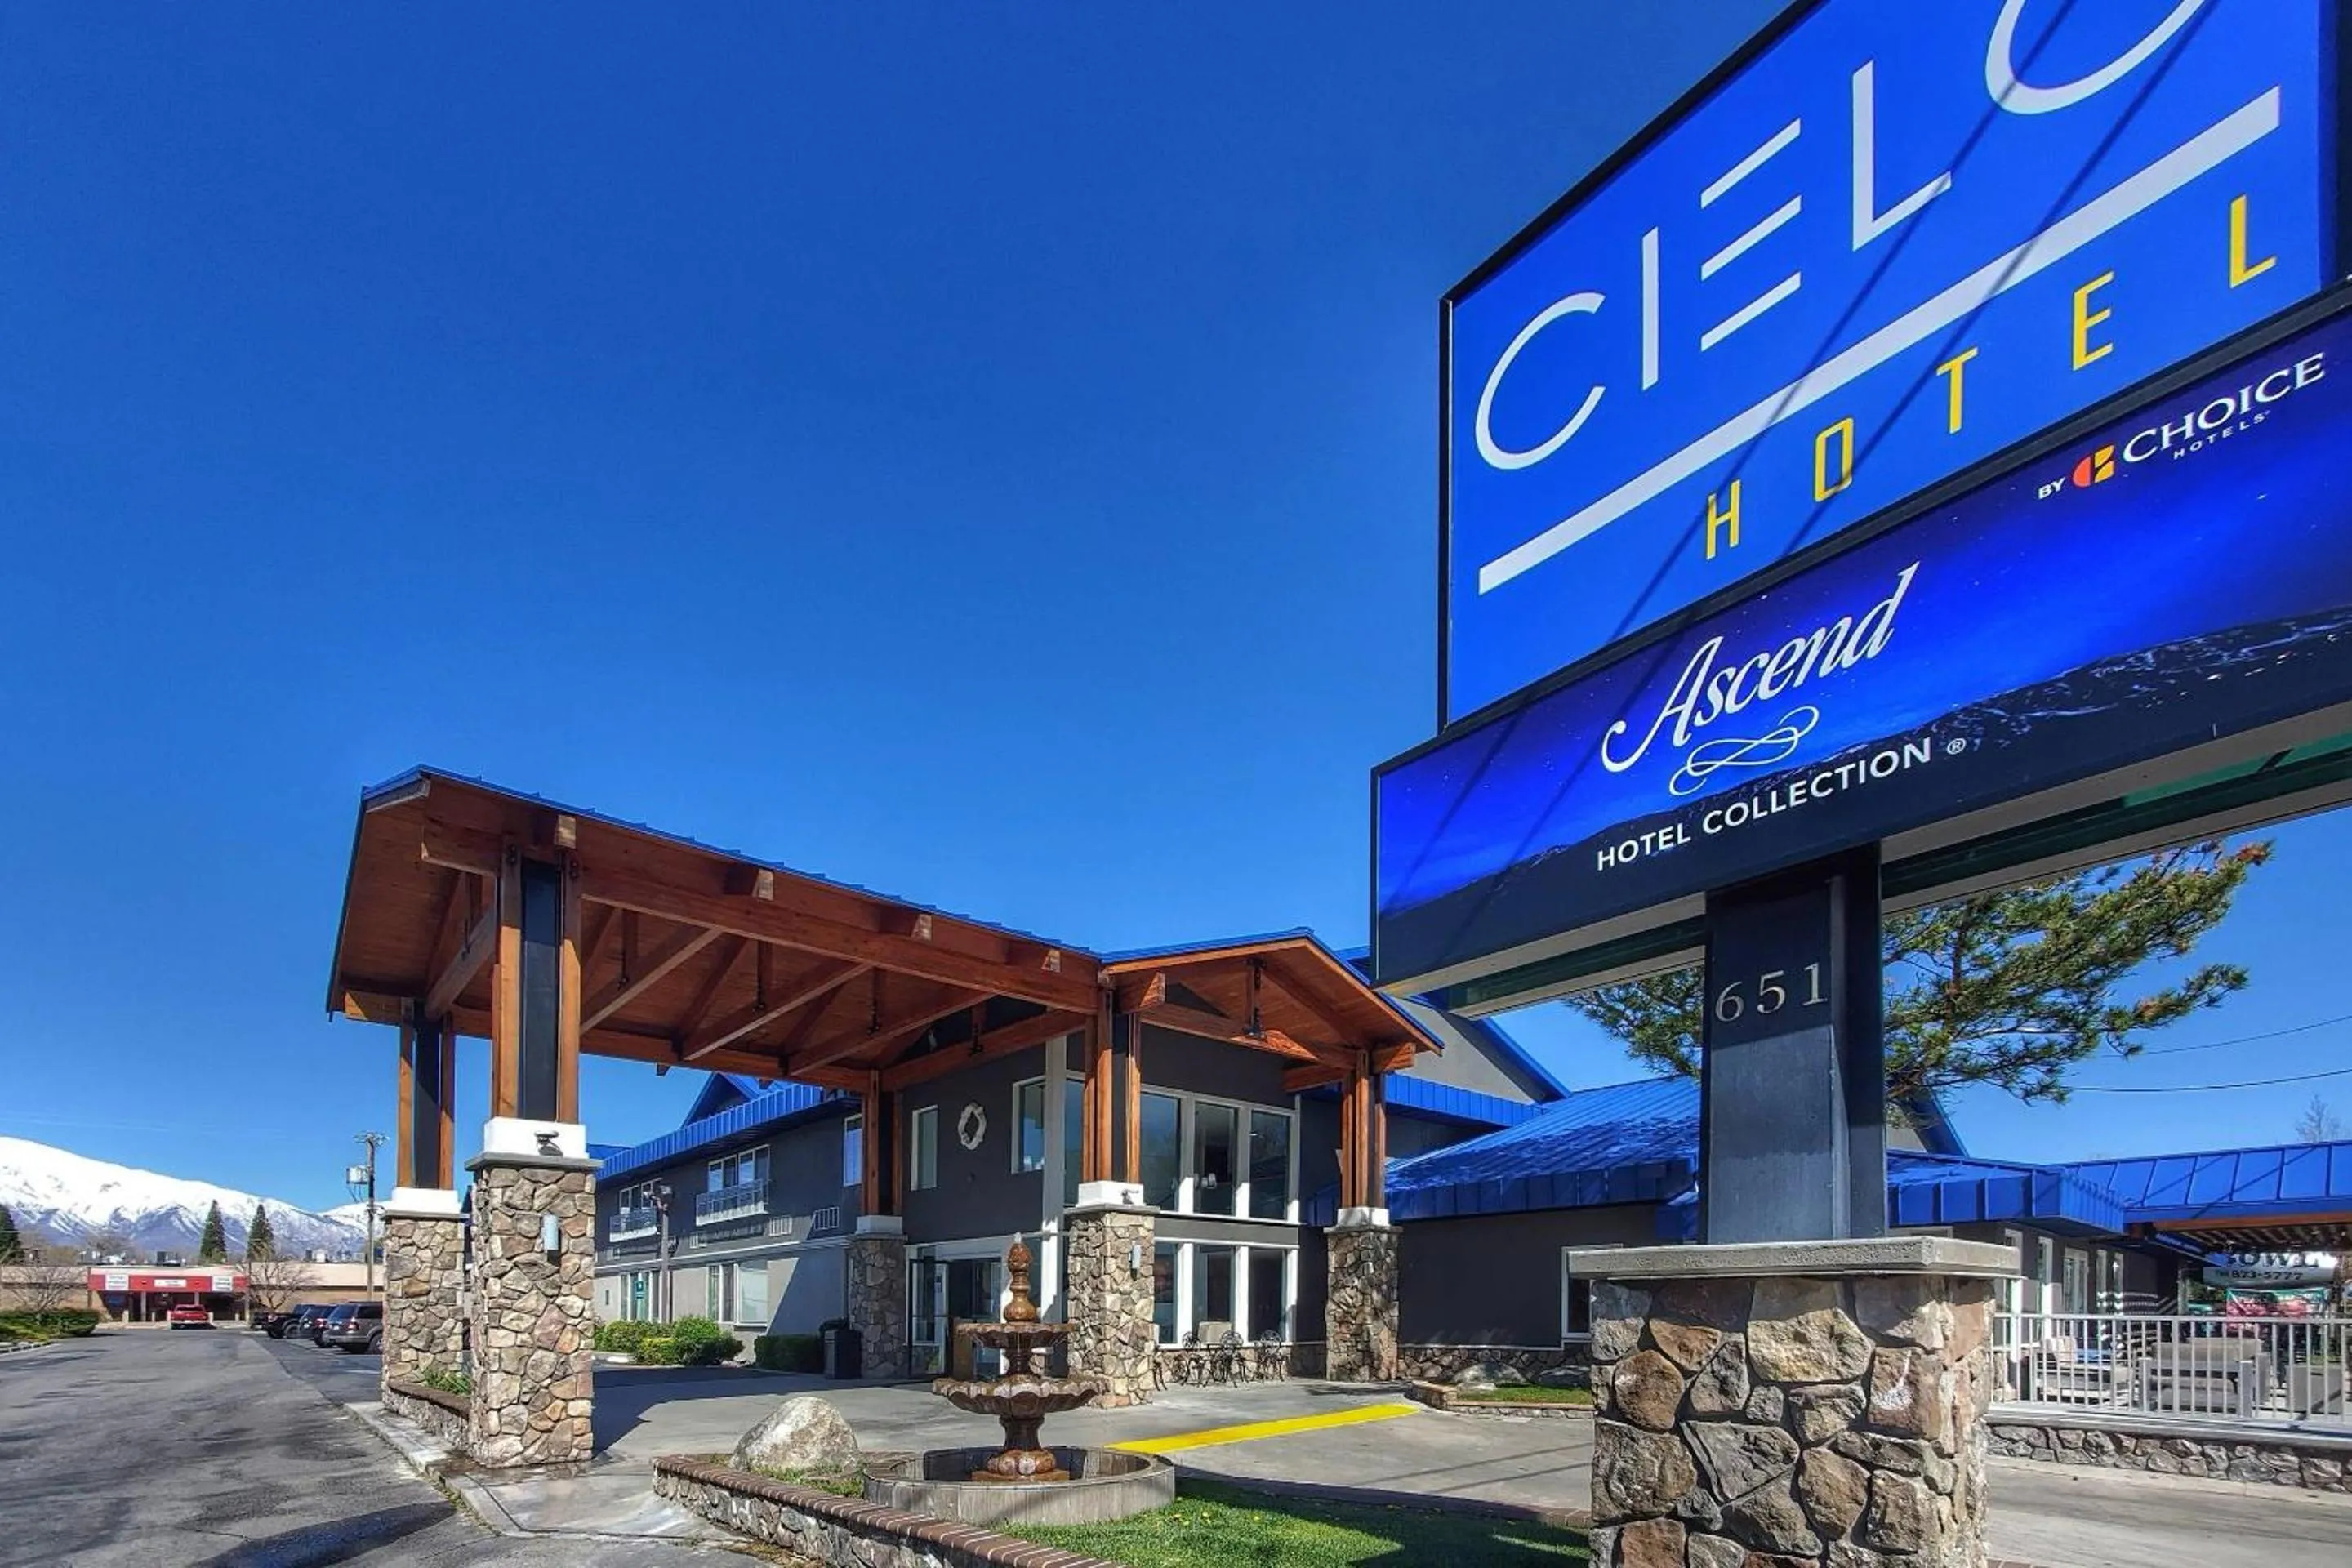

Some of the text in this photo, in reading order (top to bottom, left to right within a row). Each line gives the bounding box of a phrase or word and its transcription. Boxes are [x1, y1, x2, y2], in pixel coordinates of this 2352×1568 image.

[1704, 194, 2277, 561] HOTEL
[2038, 353, 2326, 500] BY CHOICE
[2172, 412, 2265, 461] HOTELS
[1601, 561, 1921, 773] Ascend
[1597, 822, 1691, 871] HOTEL
[1702, 737, 1931, 835] COLLECTION
[1715, 962, 1828, 1022] 651
